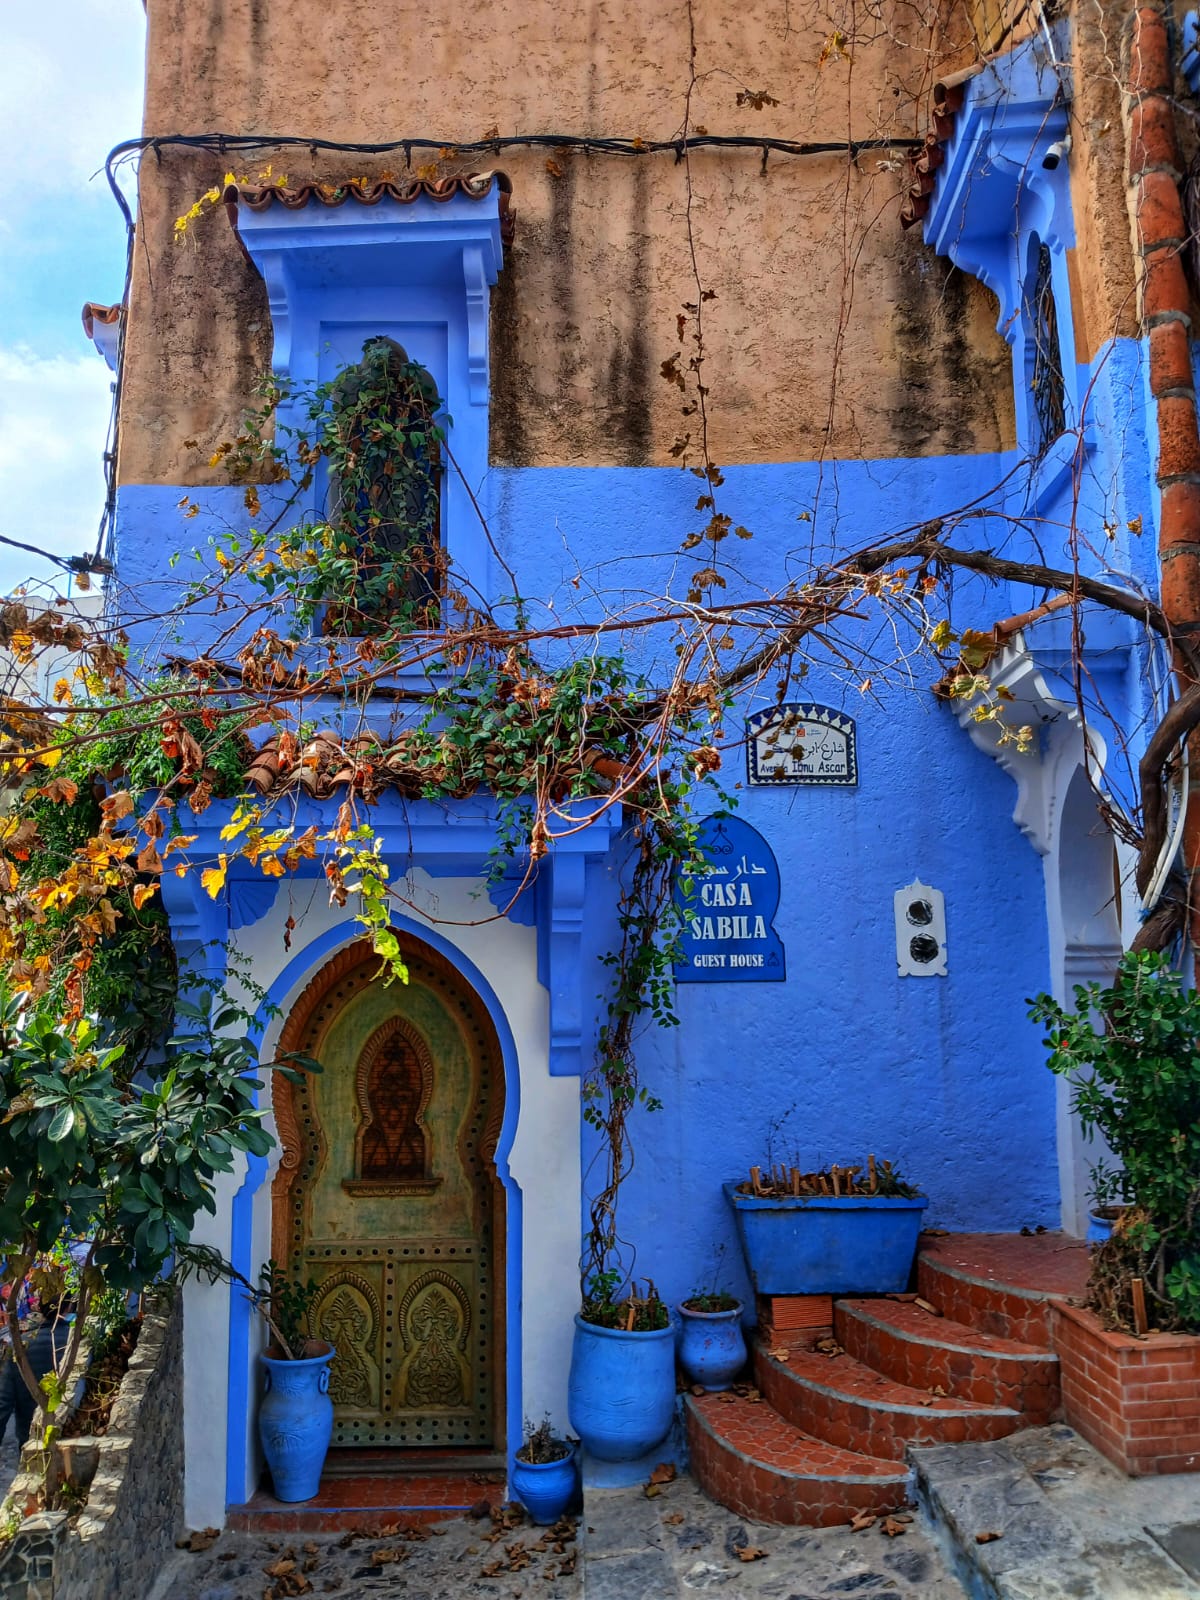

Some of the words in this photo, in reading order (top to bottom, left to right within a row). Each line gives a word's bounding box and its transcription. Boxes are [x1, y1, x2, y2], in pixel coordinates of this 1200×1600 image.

[821, 741, 845, 761] شارع
[760, 763, 789, 773] Avena
[792, 760, 814, 773] Ibnu
[818, 761, 846, 773] Ascar
[730, 855, 768, 882] دار
[701, 883, 753, 907] CASA
[691, 915, 768, 940] SABILA
[693, 954, 726, 968] GUEST
[729, 954, 765, 968] HOUSE
